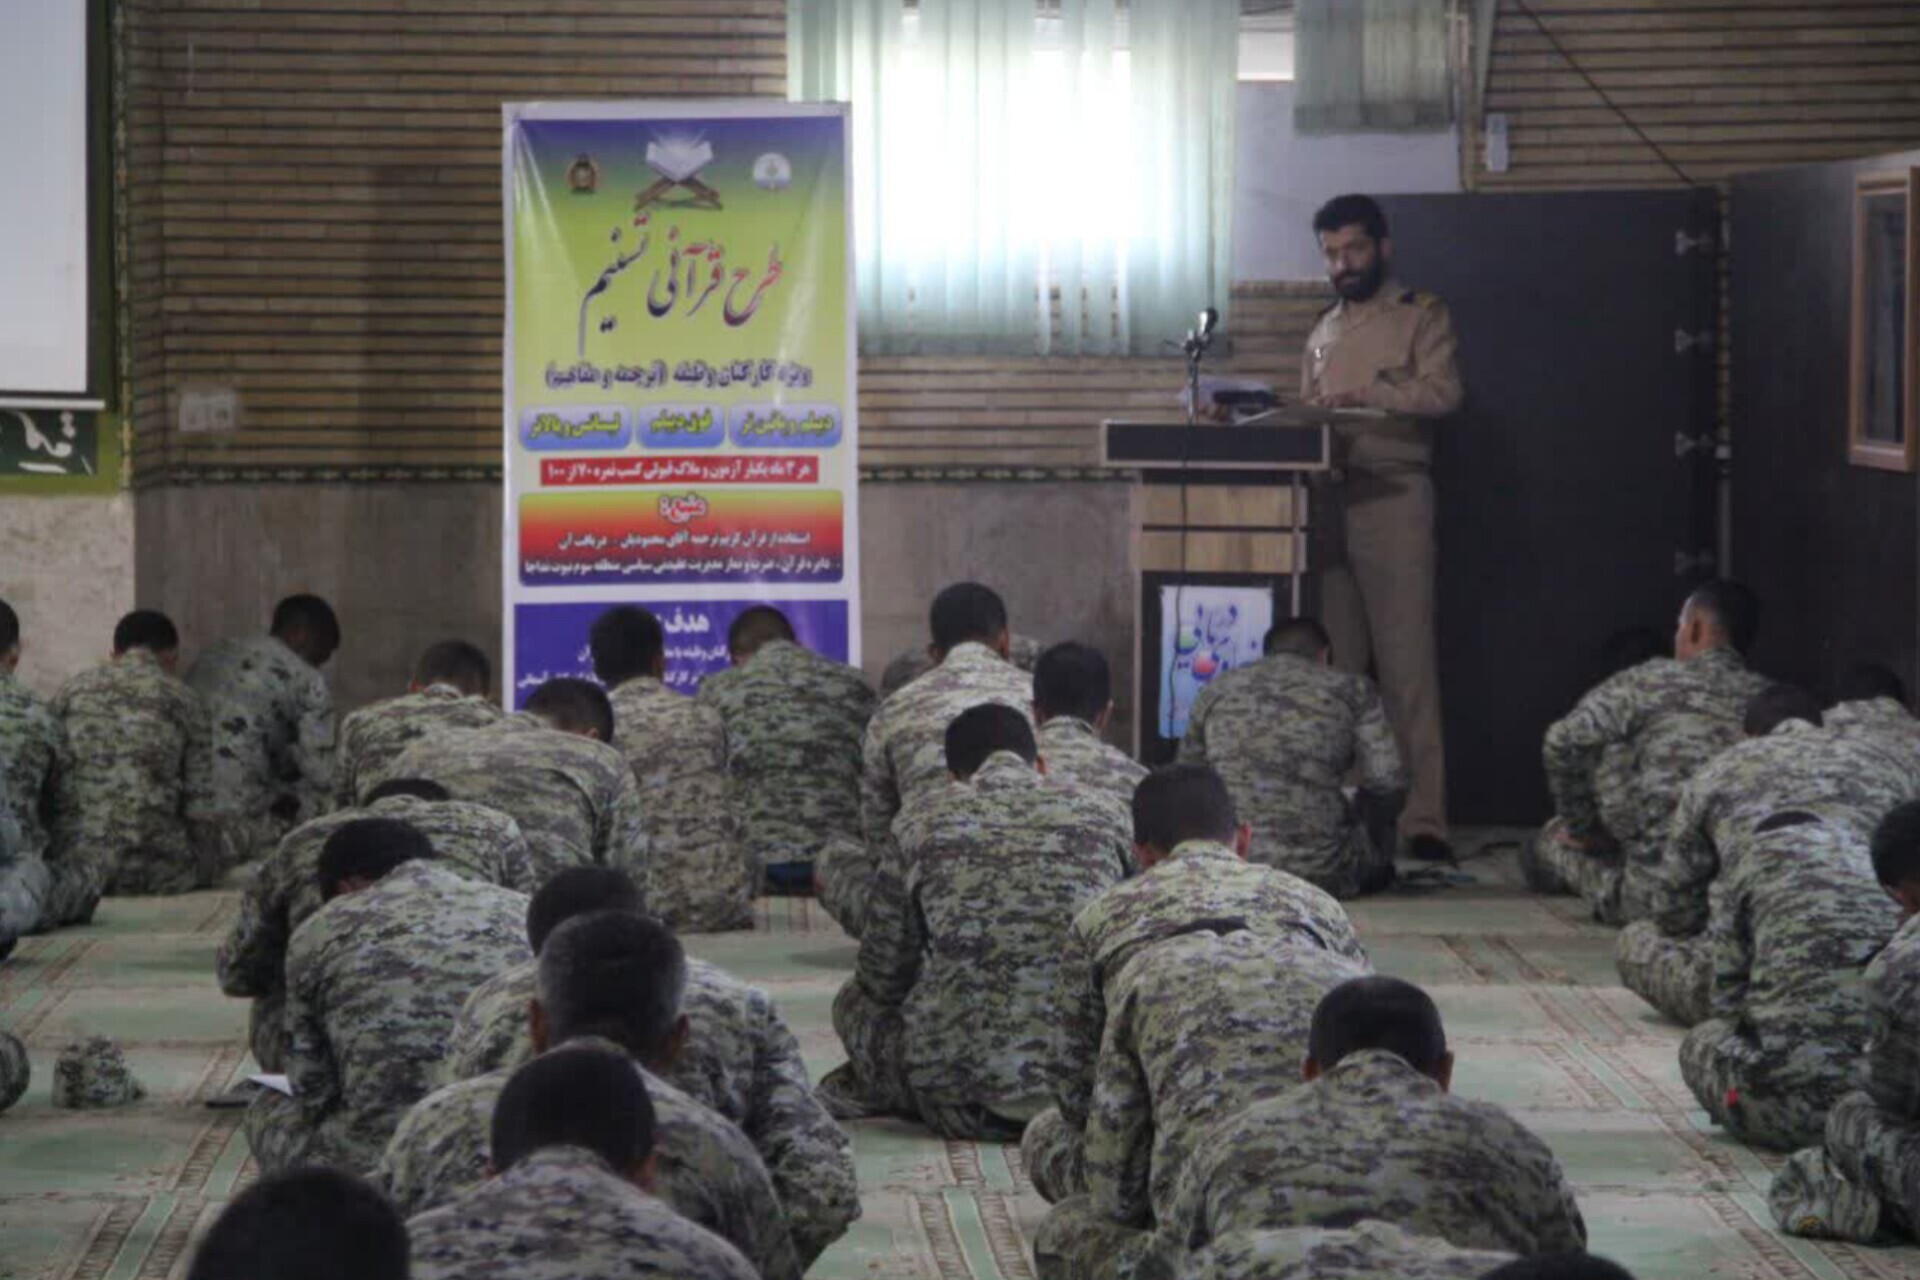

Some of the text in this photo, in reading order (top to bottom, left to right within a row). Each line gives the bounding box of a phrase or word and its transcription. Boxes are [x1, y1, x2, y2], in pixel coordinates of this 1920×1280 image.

[577, 213, 784, 357] طرح قرآنی تسنیم
[601, 368, 611, 389] و
[673, 360, 718, 389] وظیفه
[717, 359, 777, 388] کارکنان
[709, 458, 743, 480] آزمون
